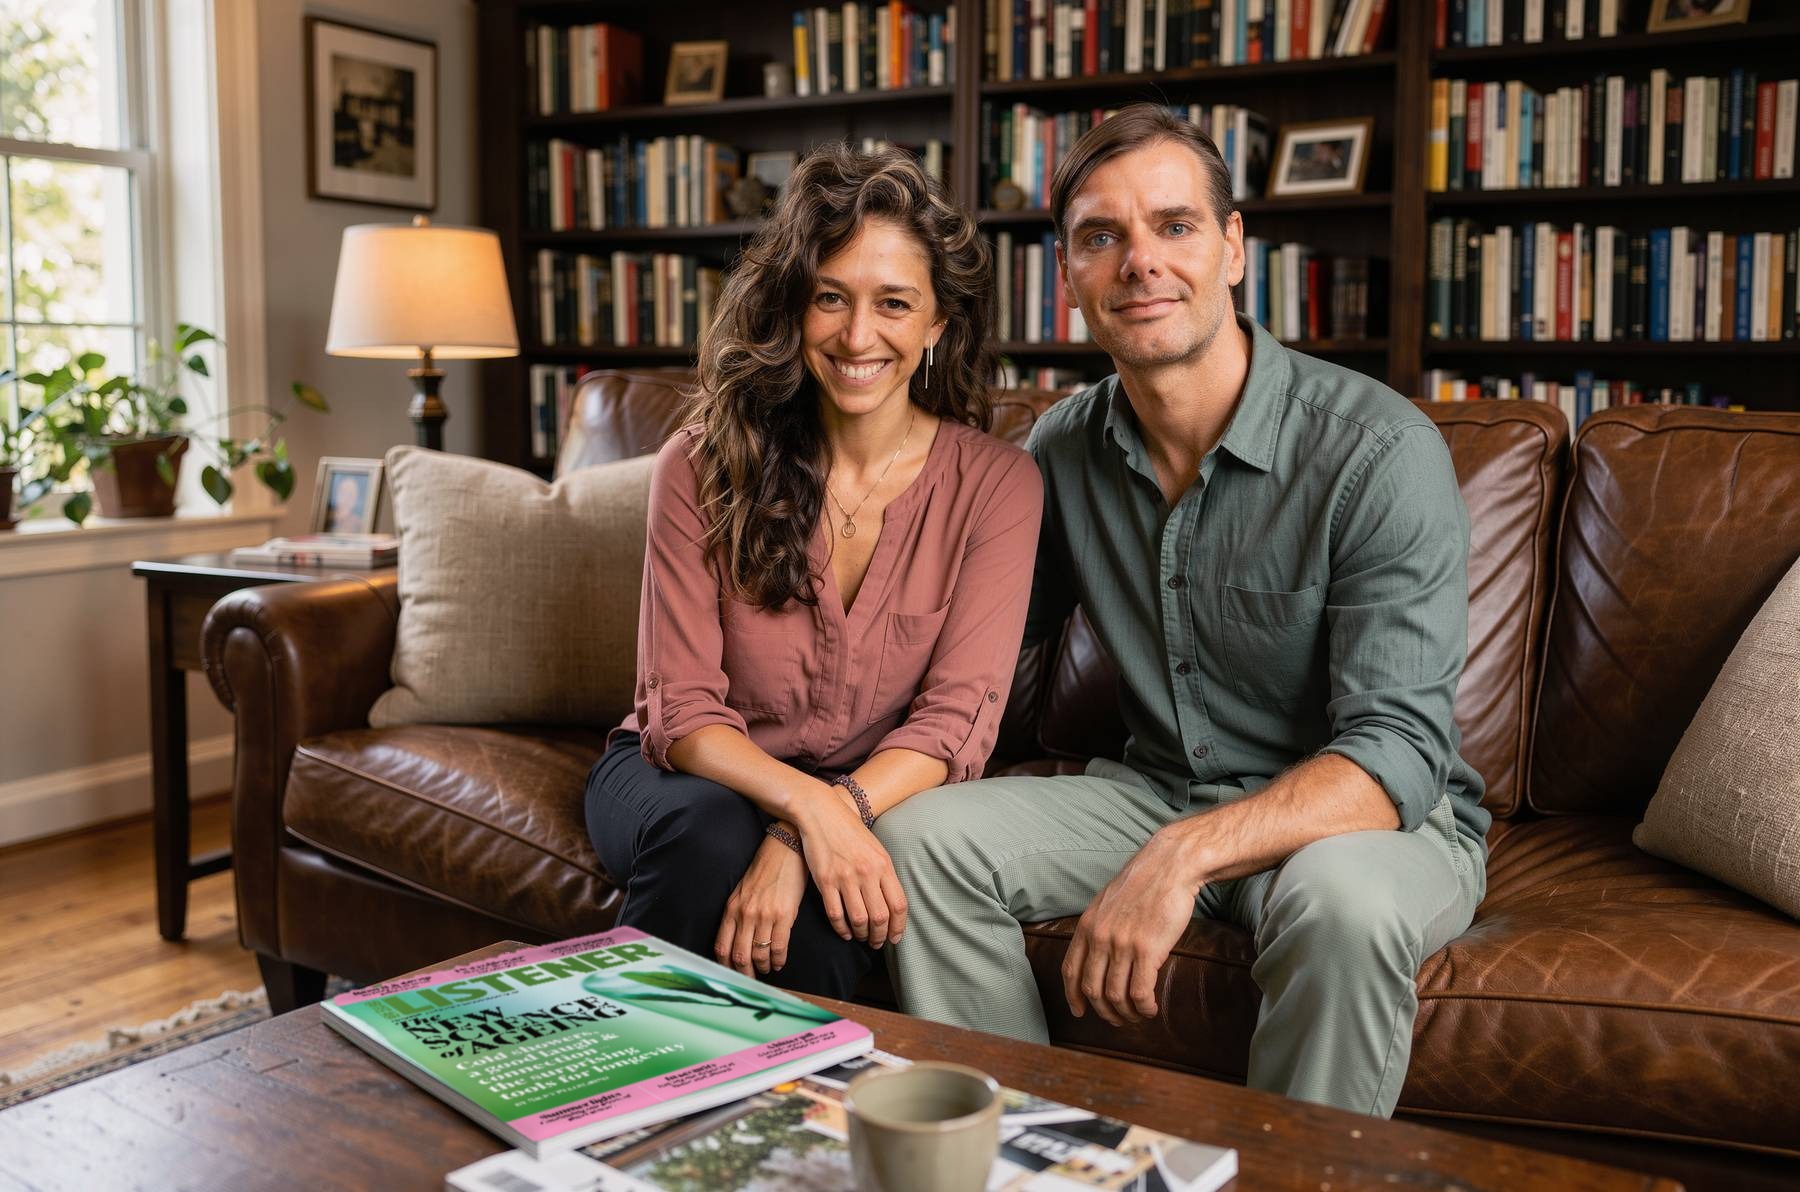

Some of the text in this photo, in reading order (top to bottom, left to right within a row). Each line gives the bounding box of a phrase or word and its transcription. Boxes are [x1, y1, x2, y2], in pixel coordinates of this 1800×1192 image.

[381, 943, 664, 1015] LISTENER
[395, 1014, 442, 1029] The
[405, 1006, 504, 1039] NEW
[421, 996, 611, 1050] SCIENCE
[440, 1044, 465, 1059] of
[470, 1004, 627, 1055] AGEING
[456, 1052, 508, 1070] Cold
[479, 1047, 598, 1085] connection
[485, 1054, 538, 1075] good
[539, 1038, 599, 1058] laugh
[489, 1078, 527, 1093] the
[530, 1046, 640, 1082] surprising
[501, 1043, 685, 1100] tools for longevity
